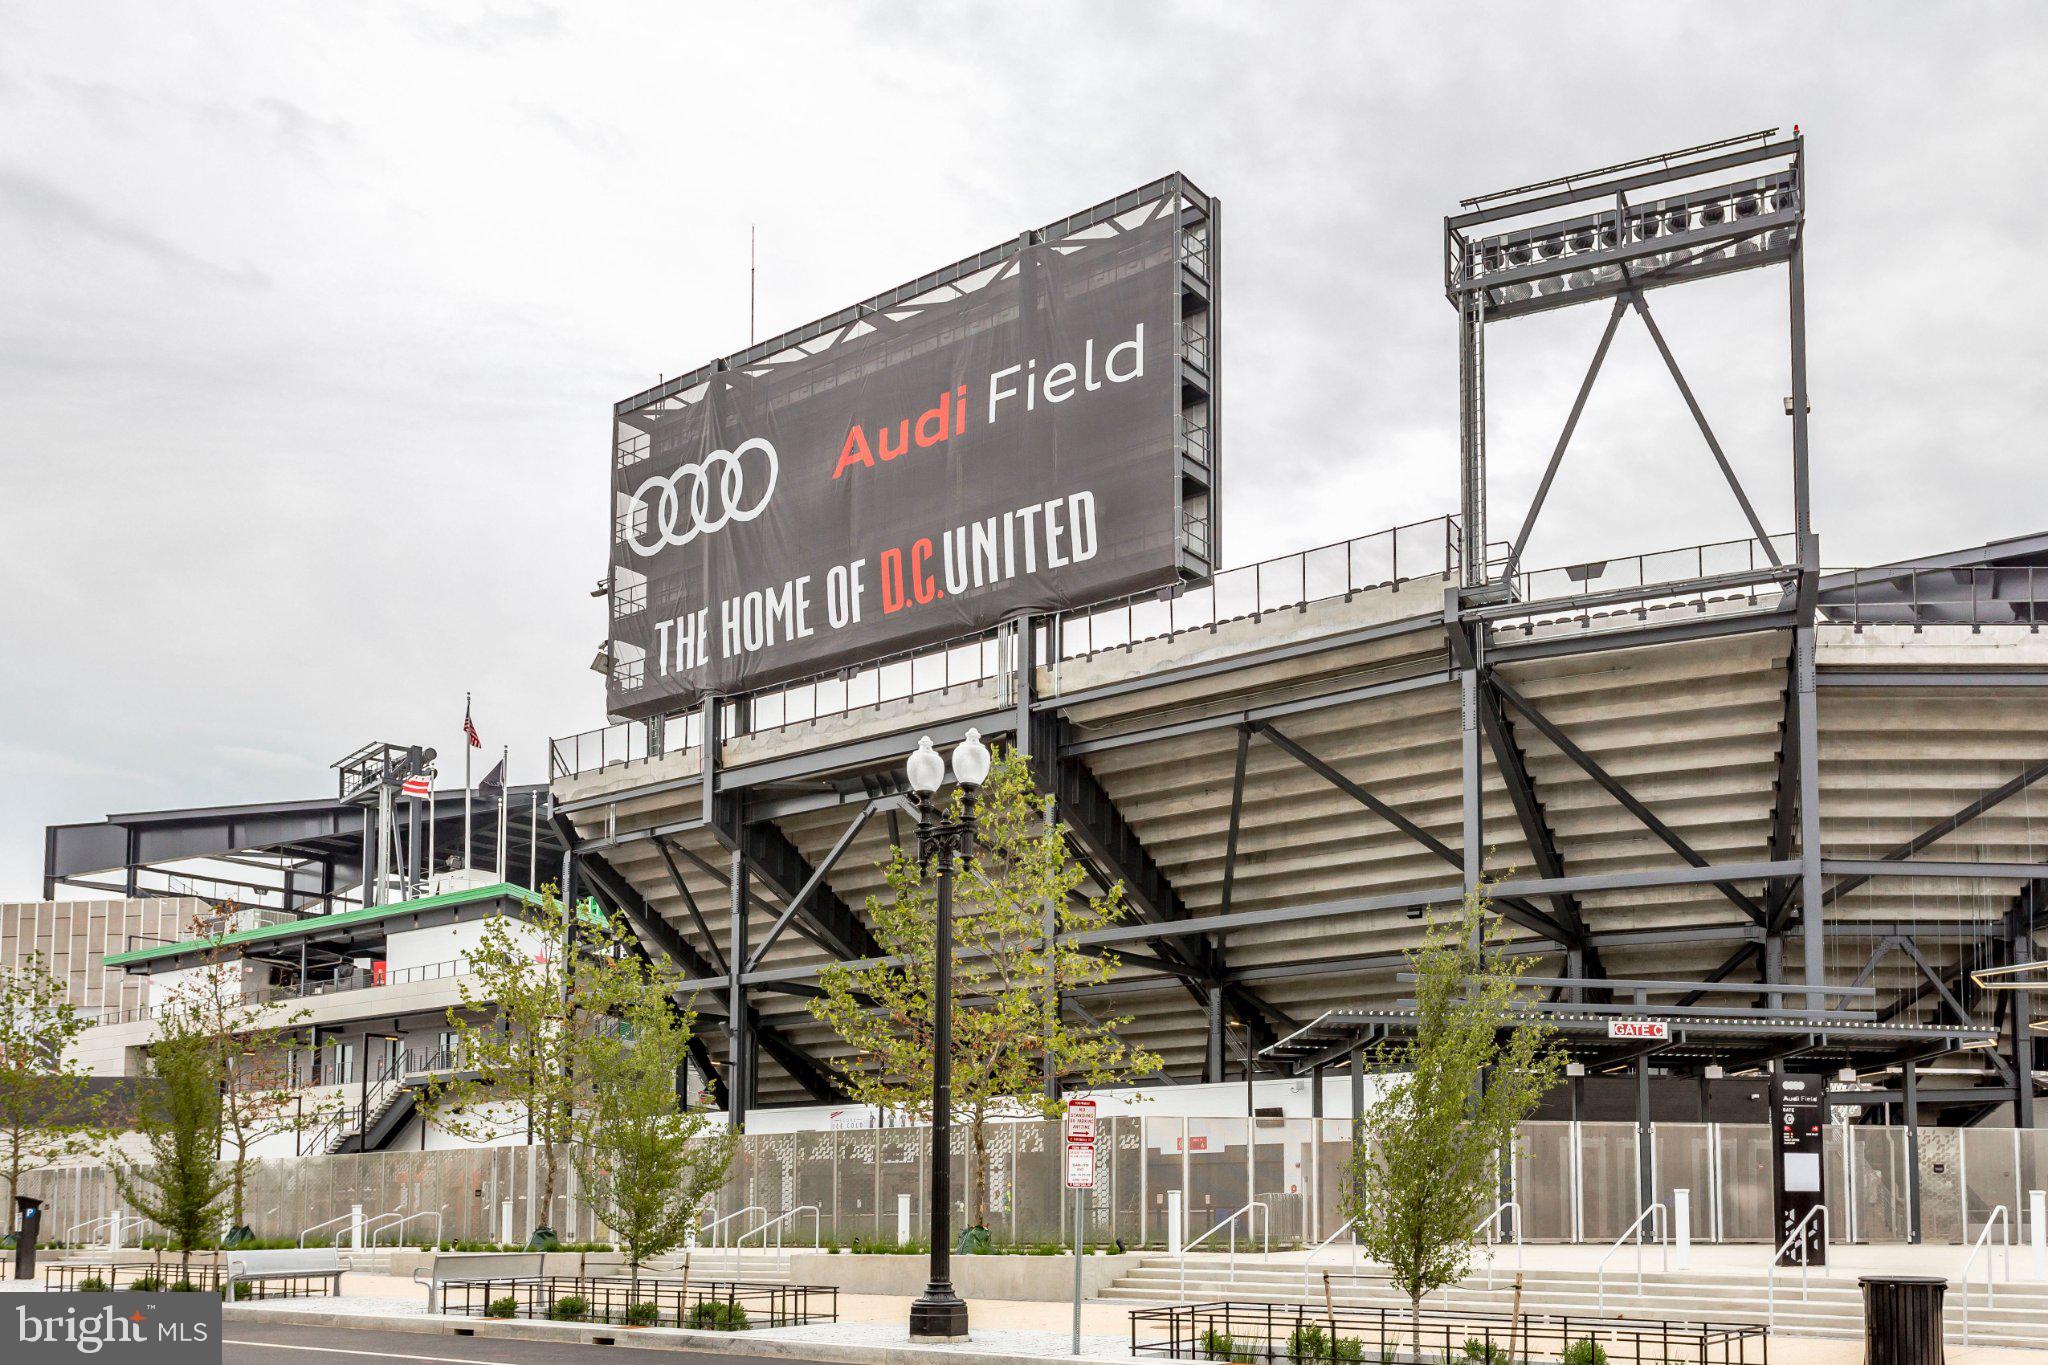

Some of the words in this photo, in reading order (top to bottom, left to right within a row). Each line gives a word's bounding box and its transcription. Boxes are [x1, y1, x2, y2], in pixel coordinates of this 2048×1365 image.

[831, 385, 968, 480] Audi
[988, 322, 1146, 424] Field
[654, 606, 708, 678] THE
[721, 575, 813, 658] HOME
[826, 558, 867, 630] OF
[1615, 1024, 1651, 1036] GATE
[1653, 1025, 1663, 1036] C
[26, 1208, 33, 1217] P
